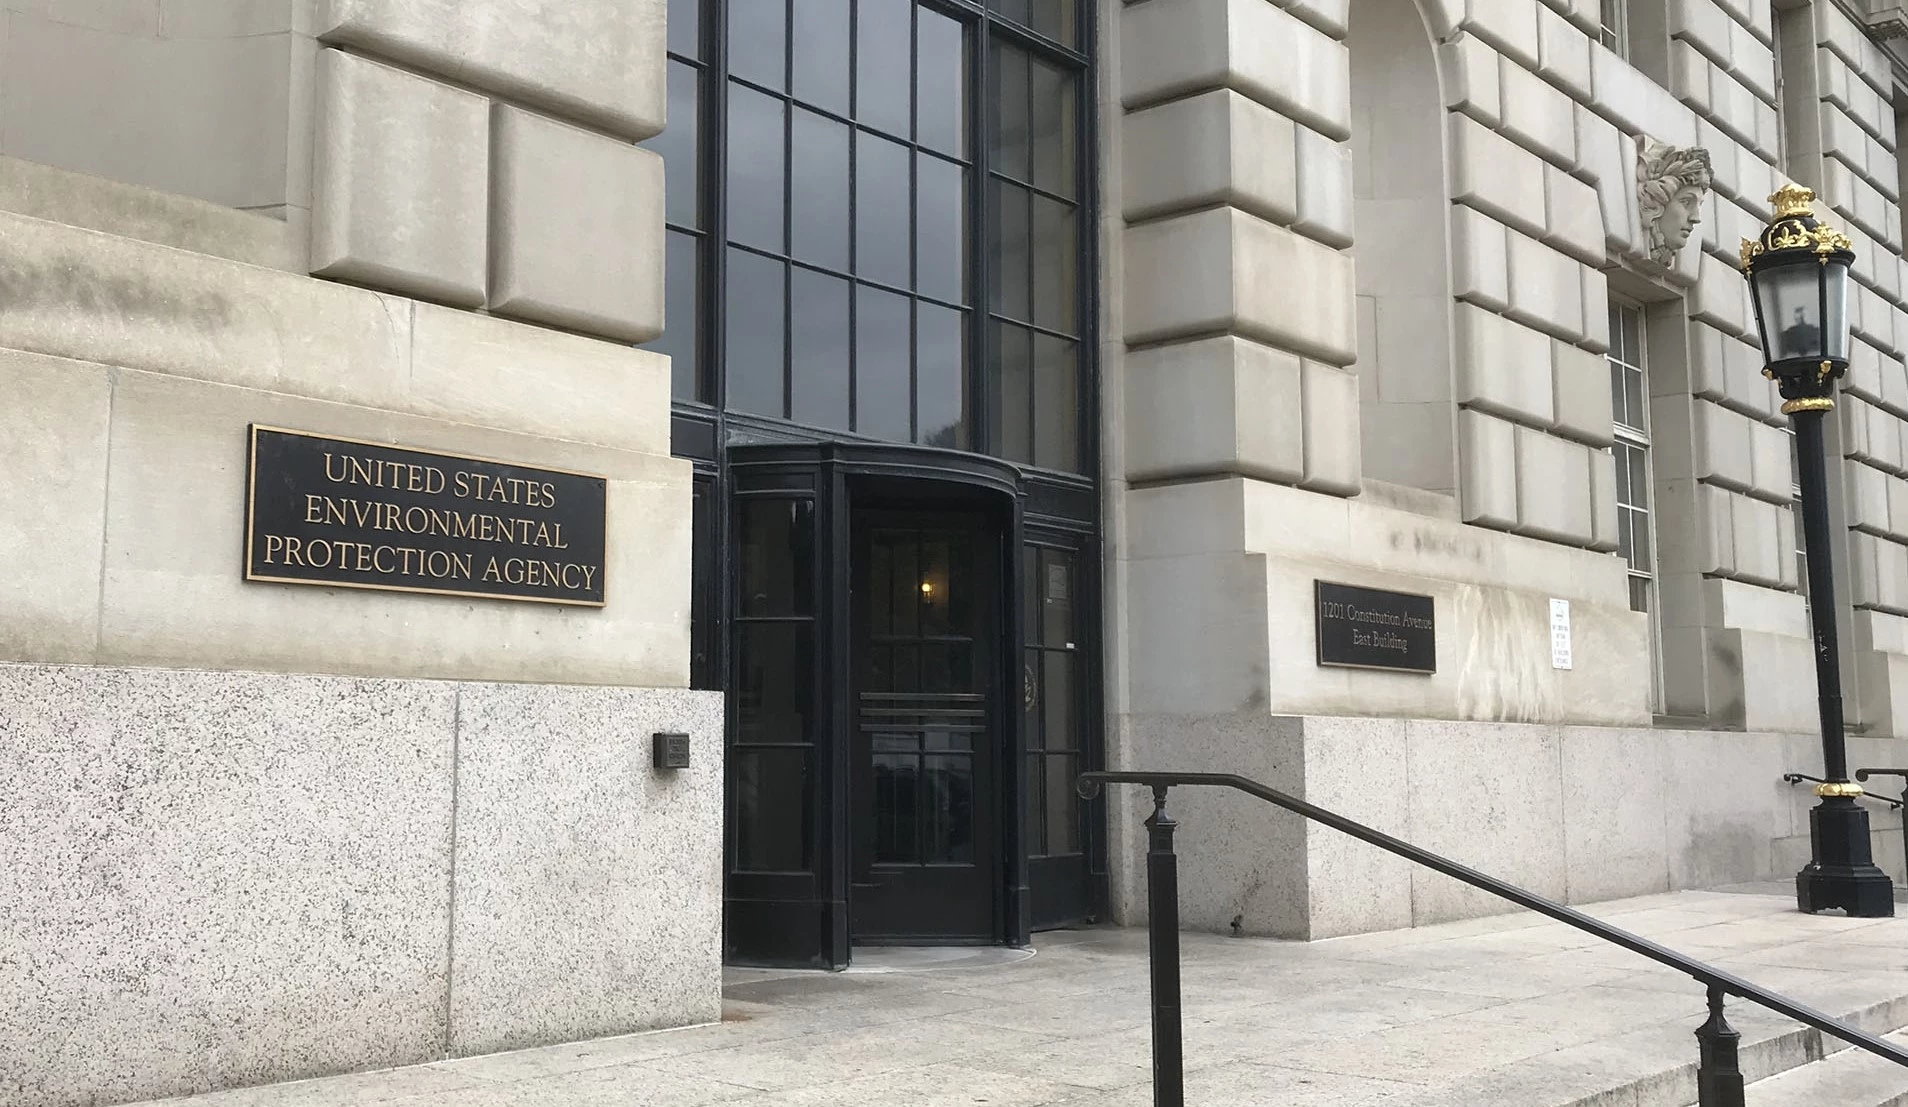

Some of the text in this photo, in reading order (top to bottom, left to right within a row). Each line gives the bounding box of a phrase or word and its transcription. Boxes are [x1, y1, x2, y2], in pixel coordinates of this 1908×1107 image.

[324, 452, 556, 509] UNITED STATES
[304, 494, 569, 549] ENVIRONMENTAL
[264, 534, 597, 592] PROTECTION AGENCY
[1323, 602, 1433, 630] 1201 Constitution Avenue
[1353, 628, 1408, 654] East Building
